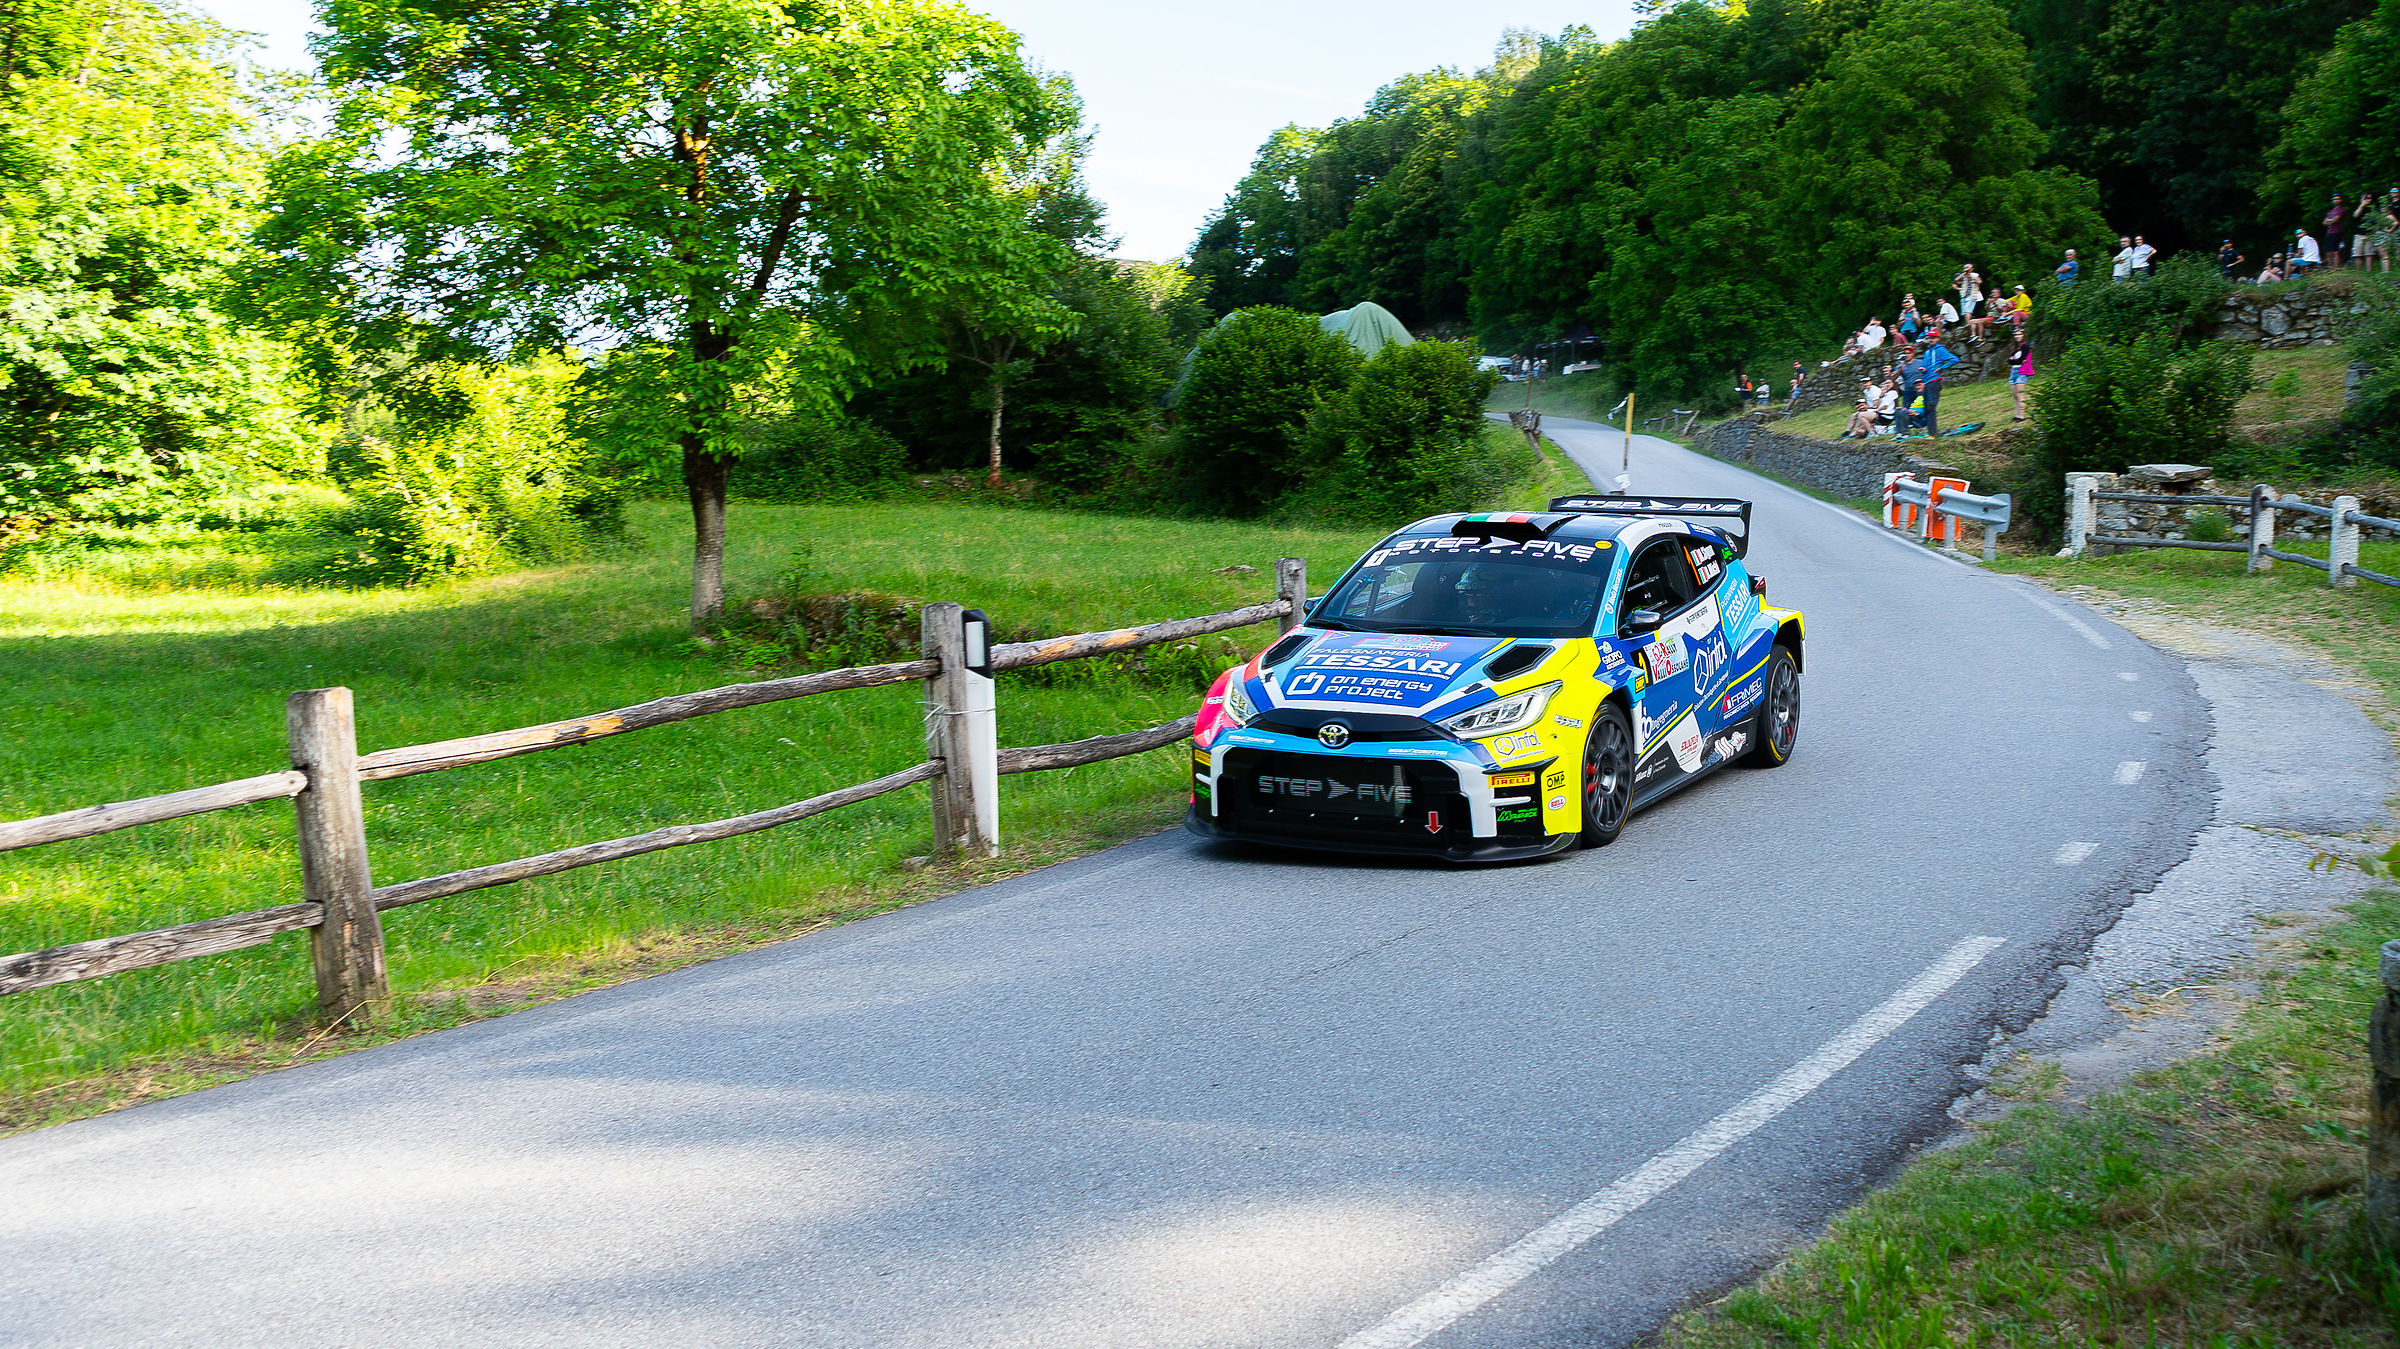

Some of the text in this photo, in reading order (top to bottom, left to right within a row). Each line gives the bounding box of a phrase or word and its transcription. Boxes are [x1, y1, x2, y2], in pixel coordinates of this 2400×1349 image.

[1560, 499, 1742, 511] STEP FIVE
[1393, 536, 1596, 559] STEP FIVE
[1388, 548, 1588, 563] MOTORSPORT
[1725, 579, 1750, 627] TESSARI
[1311, 647, 1430, 659] FALEGNAMERIA
[1302, 654, 1463, 676] TESSARI
[1652, 658, 1689, 681] VALLI OSSOLANE
[1491, 772, 1531, 786] PIRELLI
[1546, 774, 1565, 788] OMP
[1258, 775, 1413, 804] STEP FIVE
[1550, 798, 1564, 808] BELL
